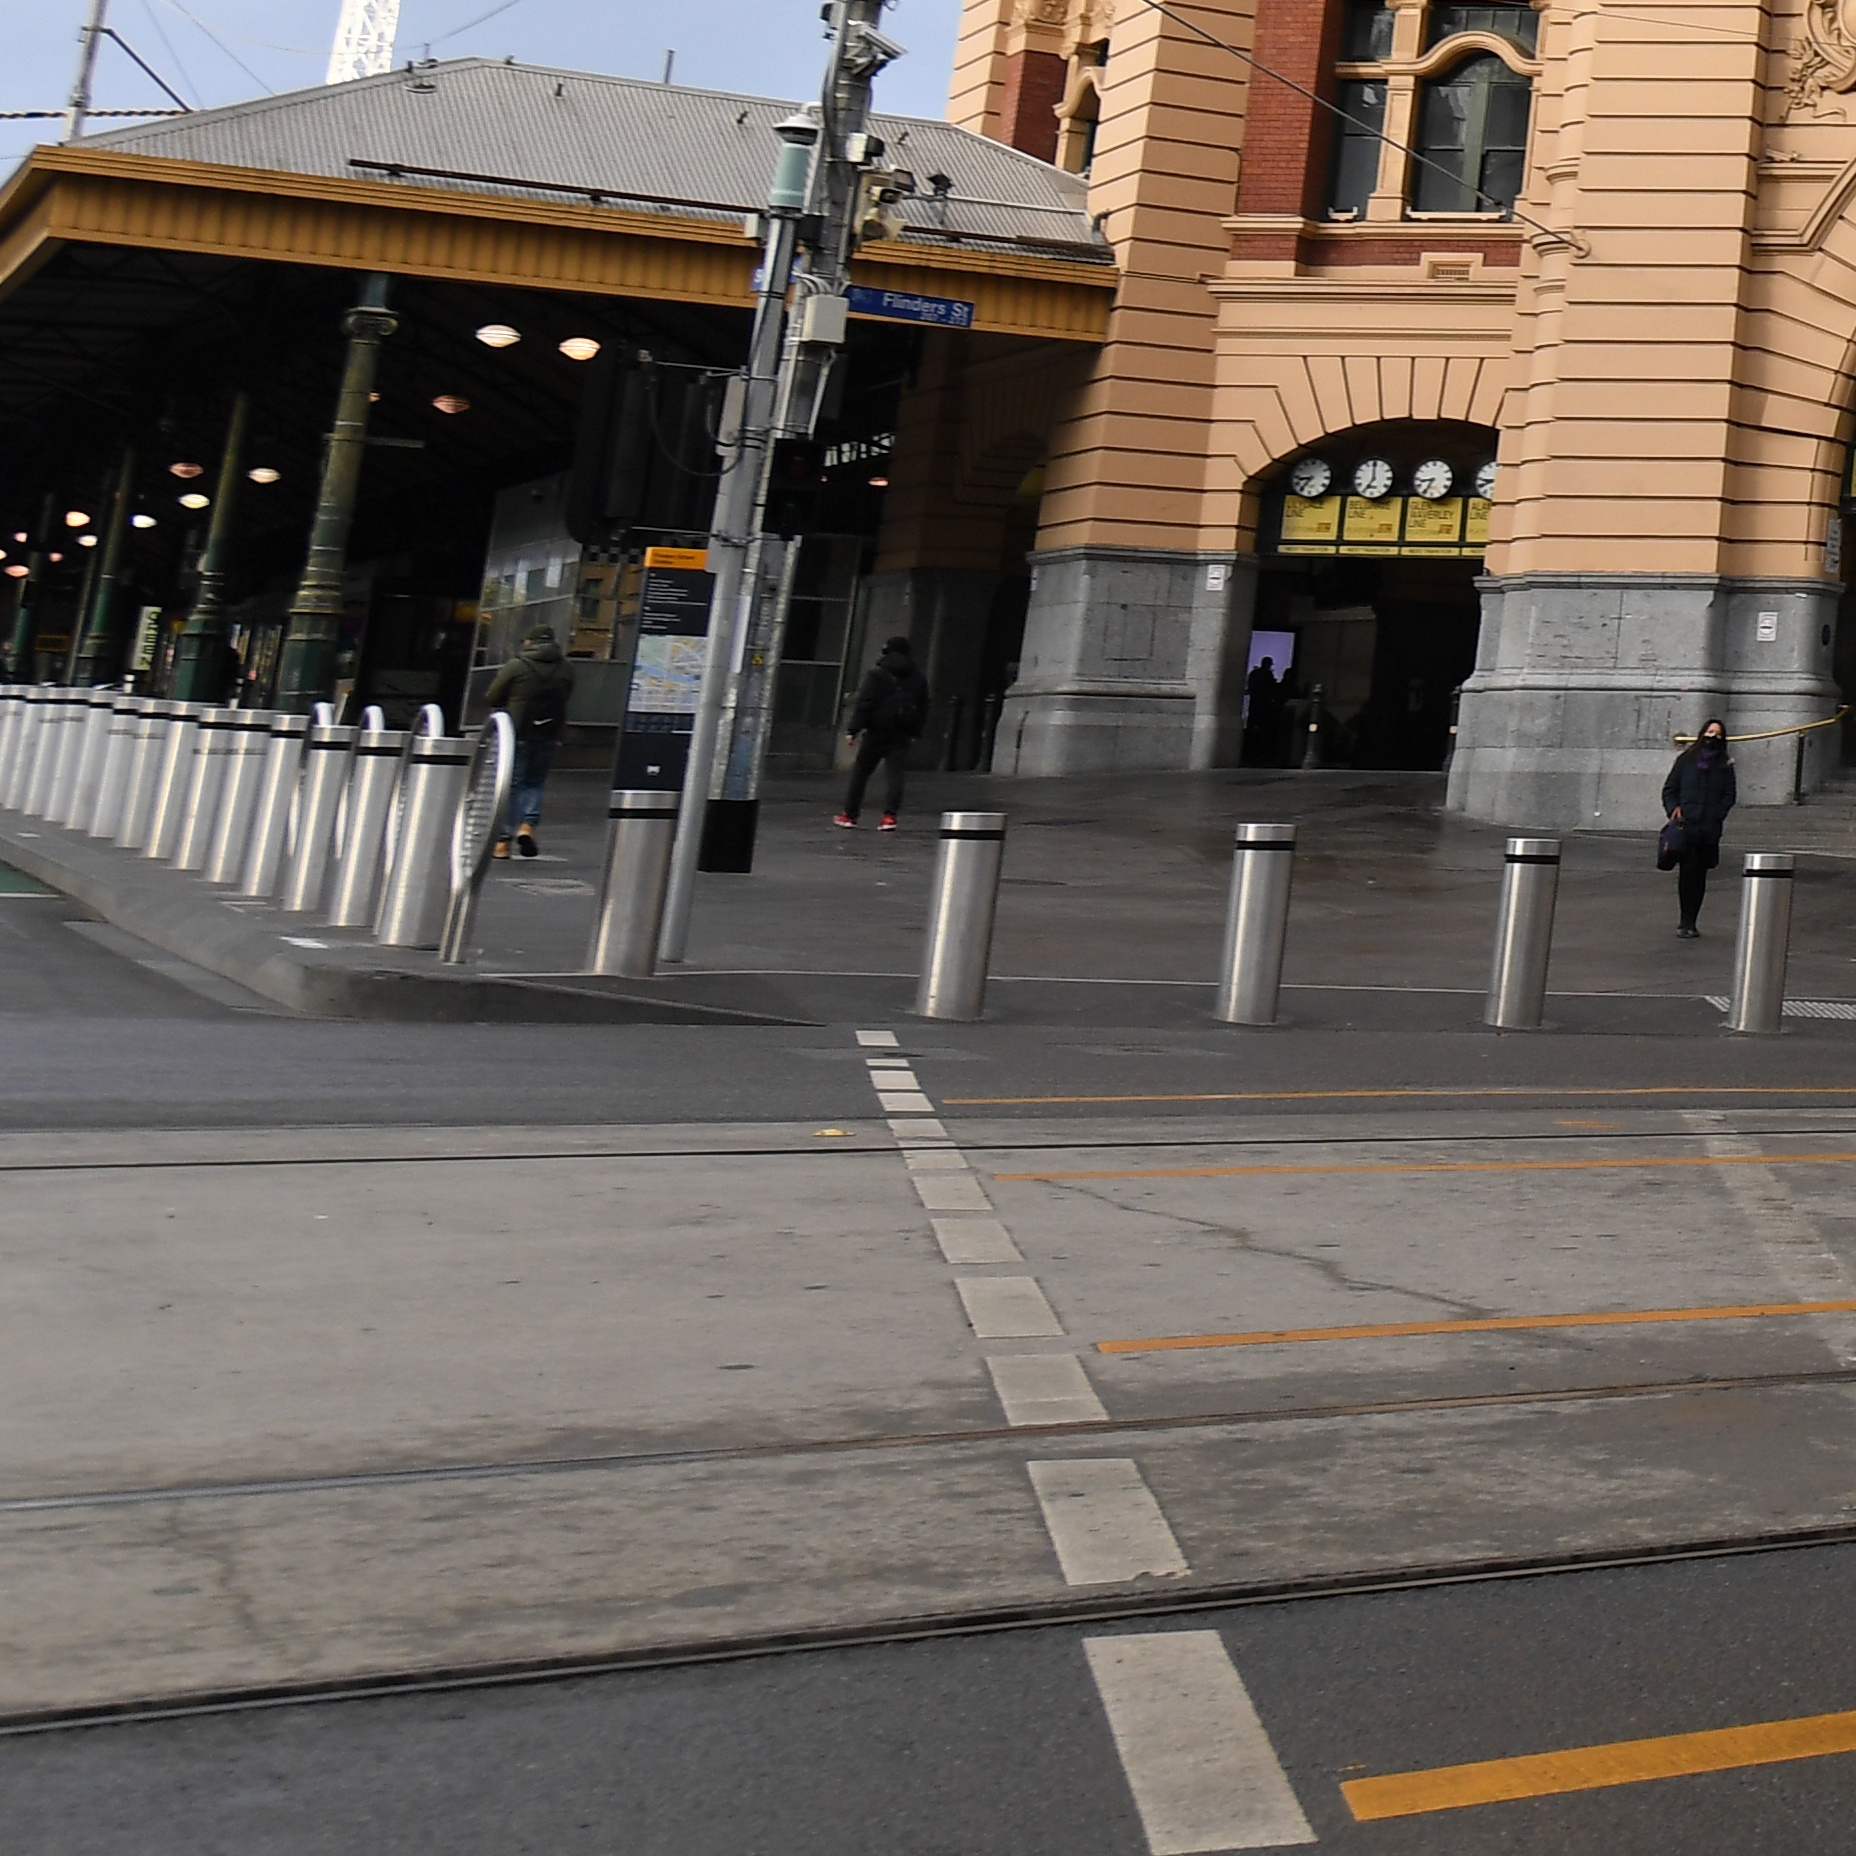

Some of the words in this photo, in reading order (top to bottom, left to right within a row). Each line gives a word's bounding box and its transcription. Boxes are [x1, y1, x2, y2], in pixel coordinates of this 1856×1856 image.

[883, 292, 946, 315] Flinders
[951, 302, 968, 318] St
[1410, 501, 1433, 510] GLEN
[1285, 509, 1304, 518] LINE
[1348, 510, 1366, 519] LINE
[1409, 511, 1454, 520] WAVERLEY
[1469, 511, 1488, 521] LINE
[1408, 519, 1426, 528] LINE
